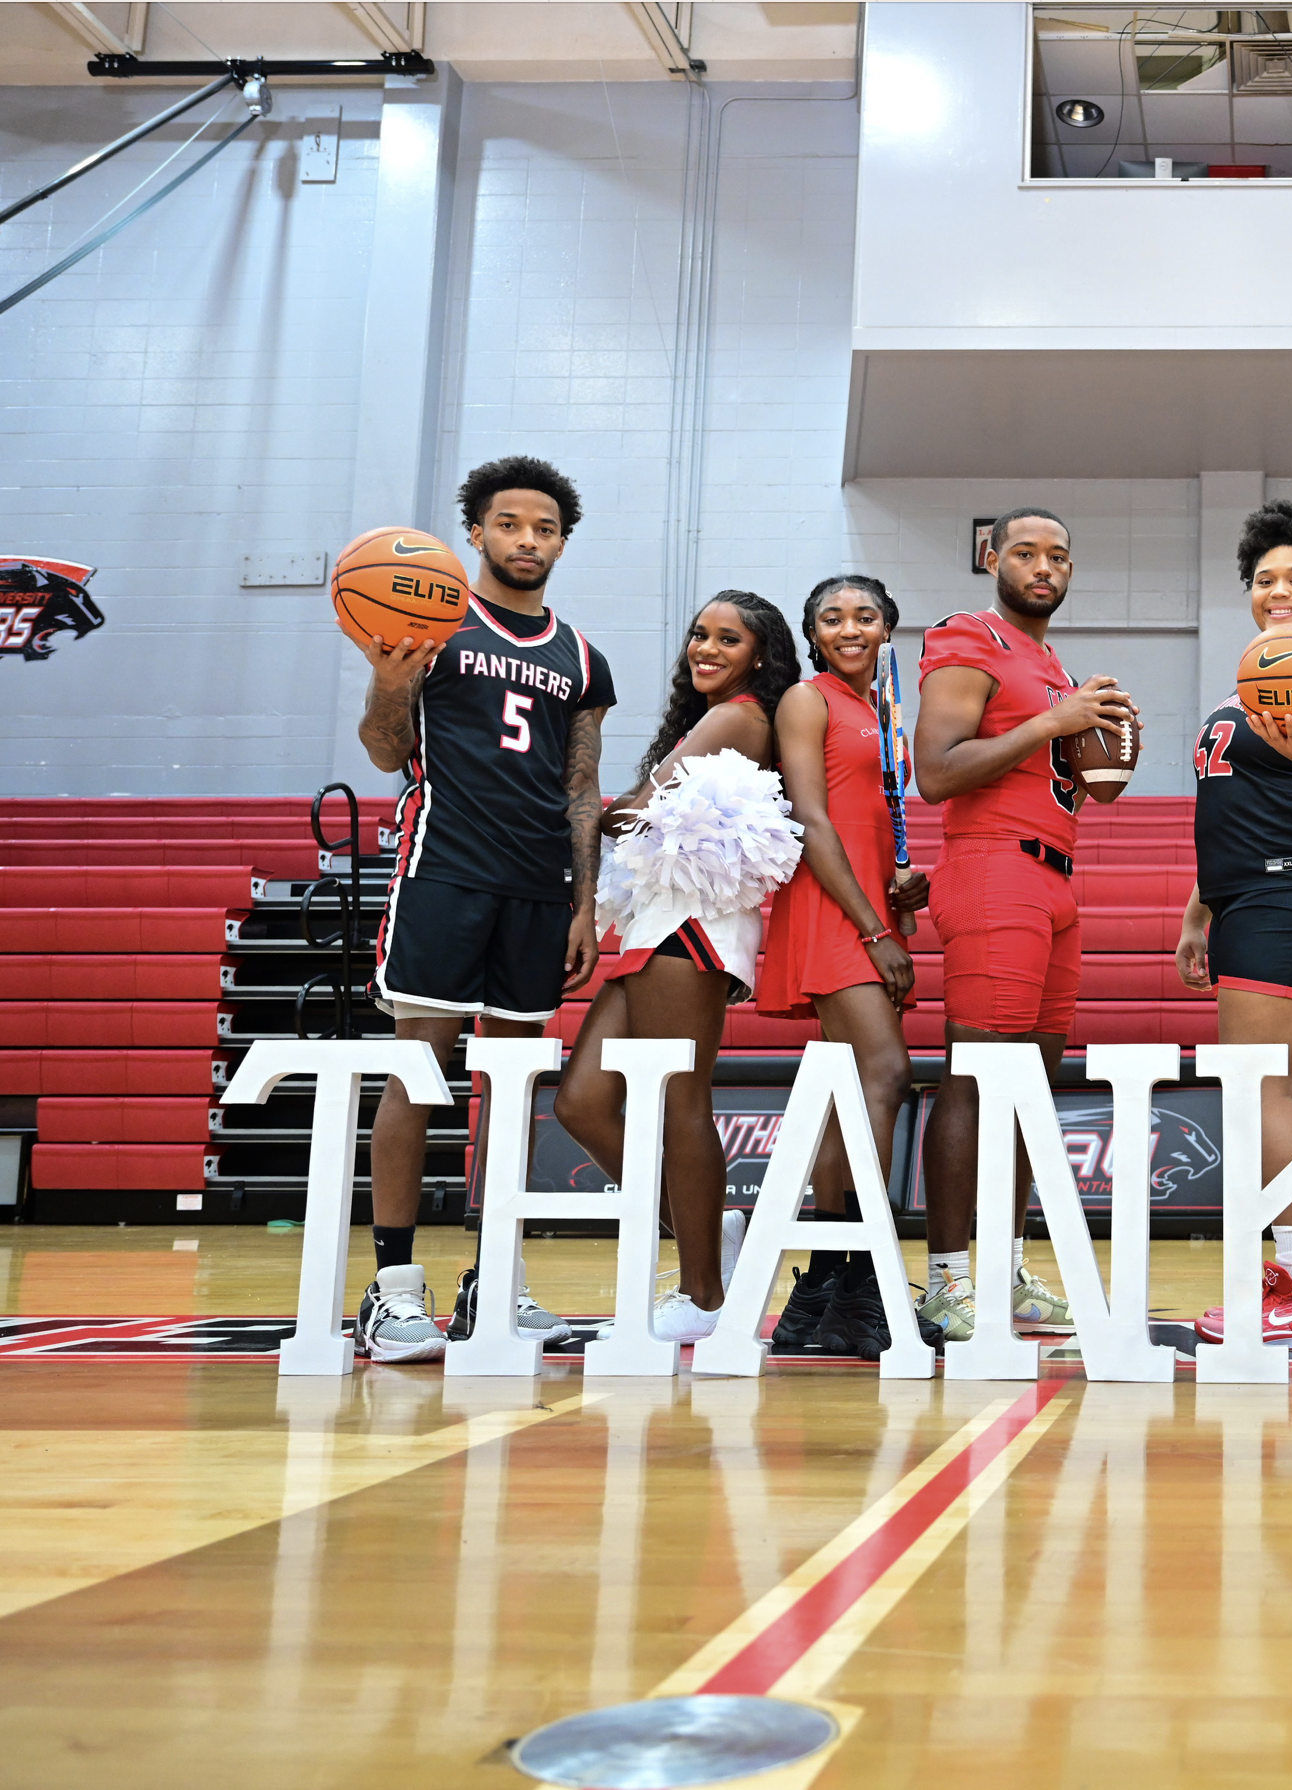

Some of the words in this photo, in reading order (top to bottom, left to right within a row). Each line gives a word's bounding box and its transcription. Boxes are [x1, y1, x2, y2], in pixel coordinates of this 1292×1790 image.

[392, 574, 460, 607] ELITE
[459, 650, 572, 701] PANTHERS
[500, 690, 534, 753] 5
[1194, 721, 1236, 780] 42
